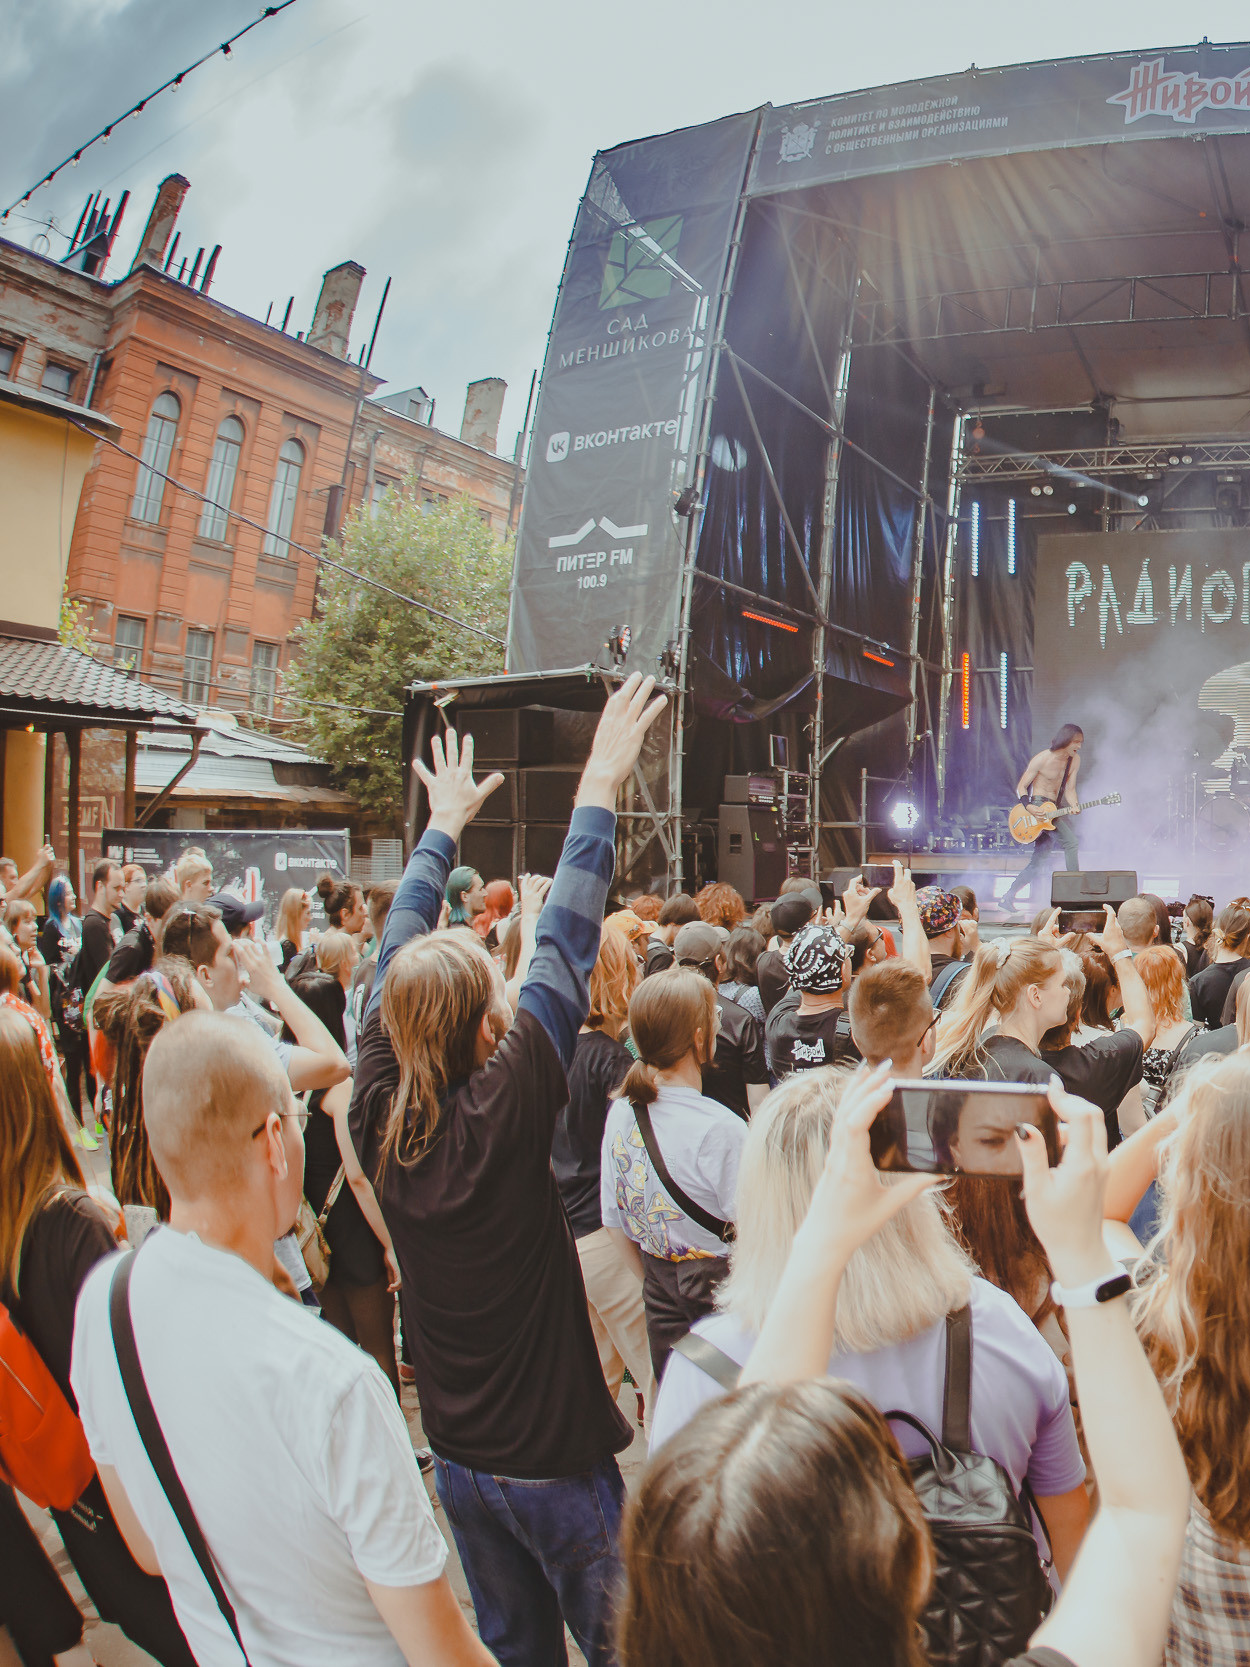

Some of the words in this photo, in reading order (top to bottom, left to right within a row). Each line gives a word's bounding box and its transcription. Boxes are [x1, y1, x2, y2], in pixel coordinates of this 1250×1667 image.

[828, 124, 877, 141] ПОЛИТИКЕ
[878, 121, 886, 131] И
[887, 106, 981, 130] ВЗАИМОДЕЙСТВИЮ
[832, 111, 874, 127] КОМИТЕТ
[875, 107, 889, 119] ПО
[825, 144, 832, 155] С
[833, 130, 919, 153] ОБЩЕСТВЕННЫМИ
[921, 117, 1009, 138] ОРГАНИЗАЦИЯМИ
[606, 313, 649, 335] САД
[559, 326, 694, 369] МЕНШИКОВА
[556, 551, 607, 573] ПИТЕР
[609, 548, 634, 566] FM
[578, 574, 608, 589] 100.9
